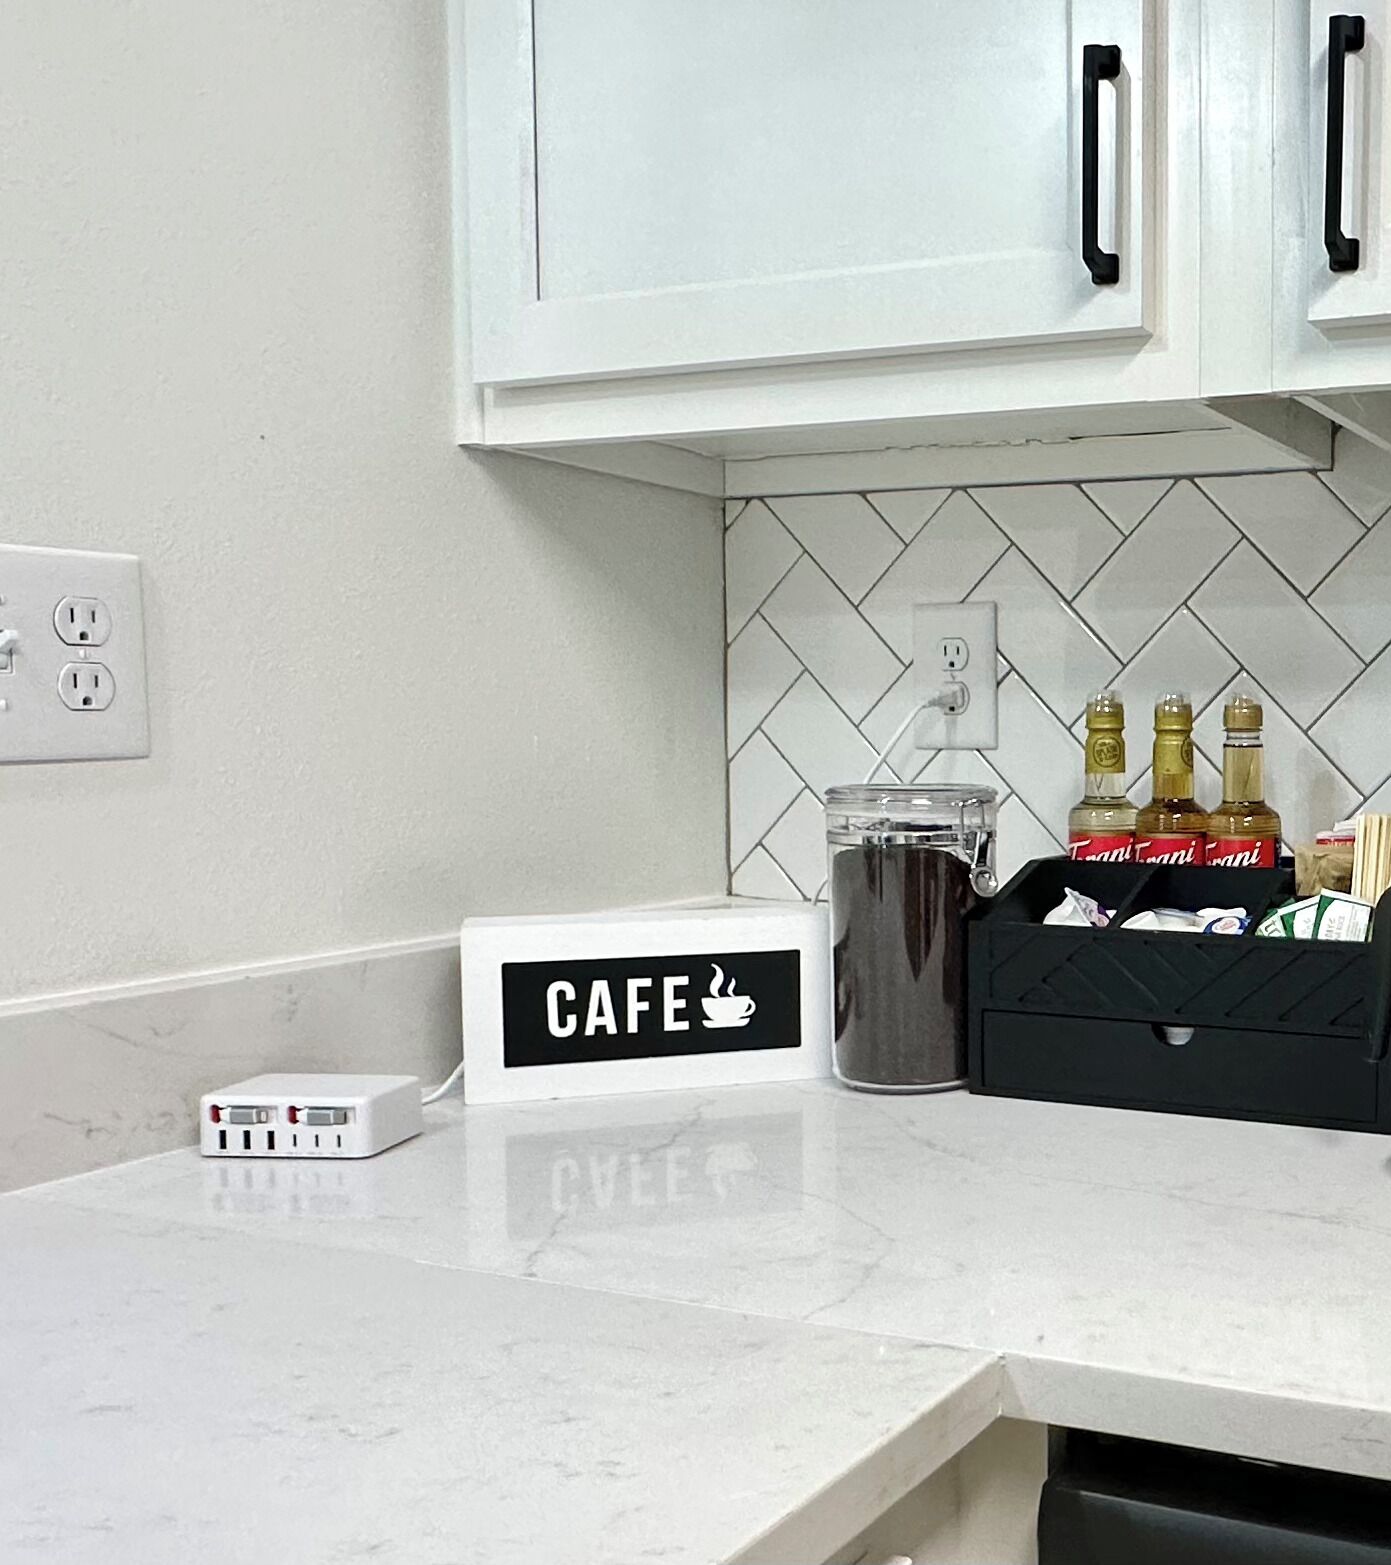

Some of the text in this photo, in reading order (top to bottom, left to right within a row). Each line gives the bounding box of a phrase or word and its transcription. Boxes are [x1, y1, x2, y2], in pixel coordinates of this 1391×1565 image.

[1068, 838, 1134, 861] Tani
[1134, 841, 1196, 864] Trani
[1205, 841, 1262, 867] Trani
[546, 975, 690, 1038] CAFE
